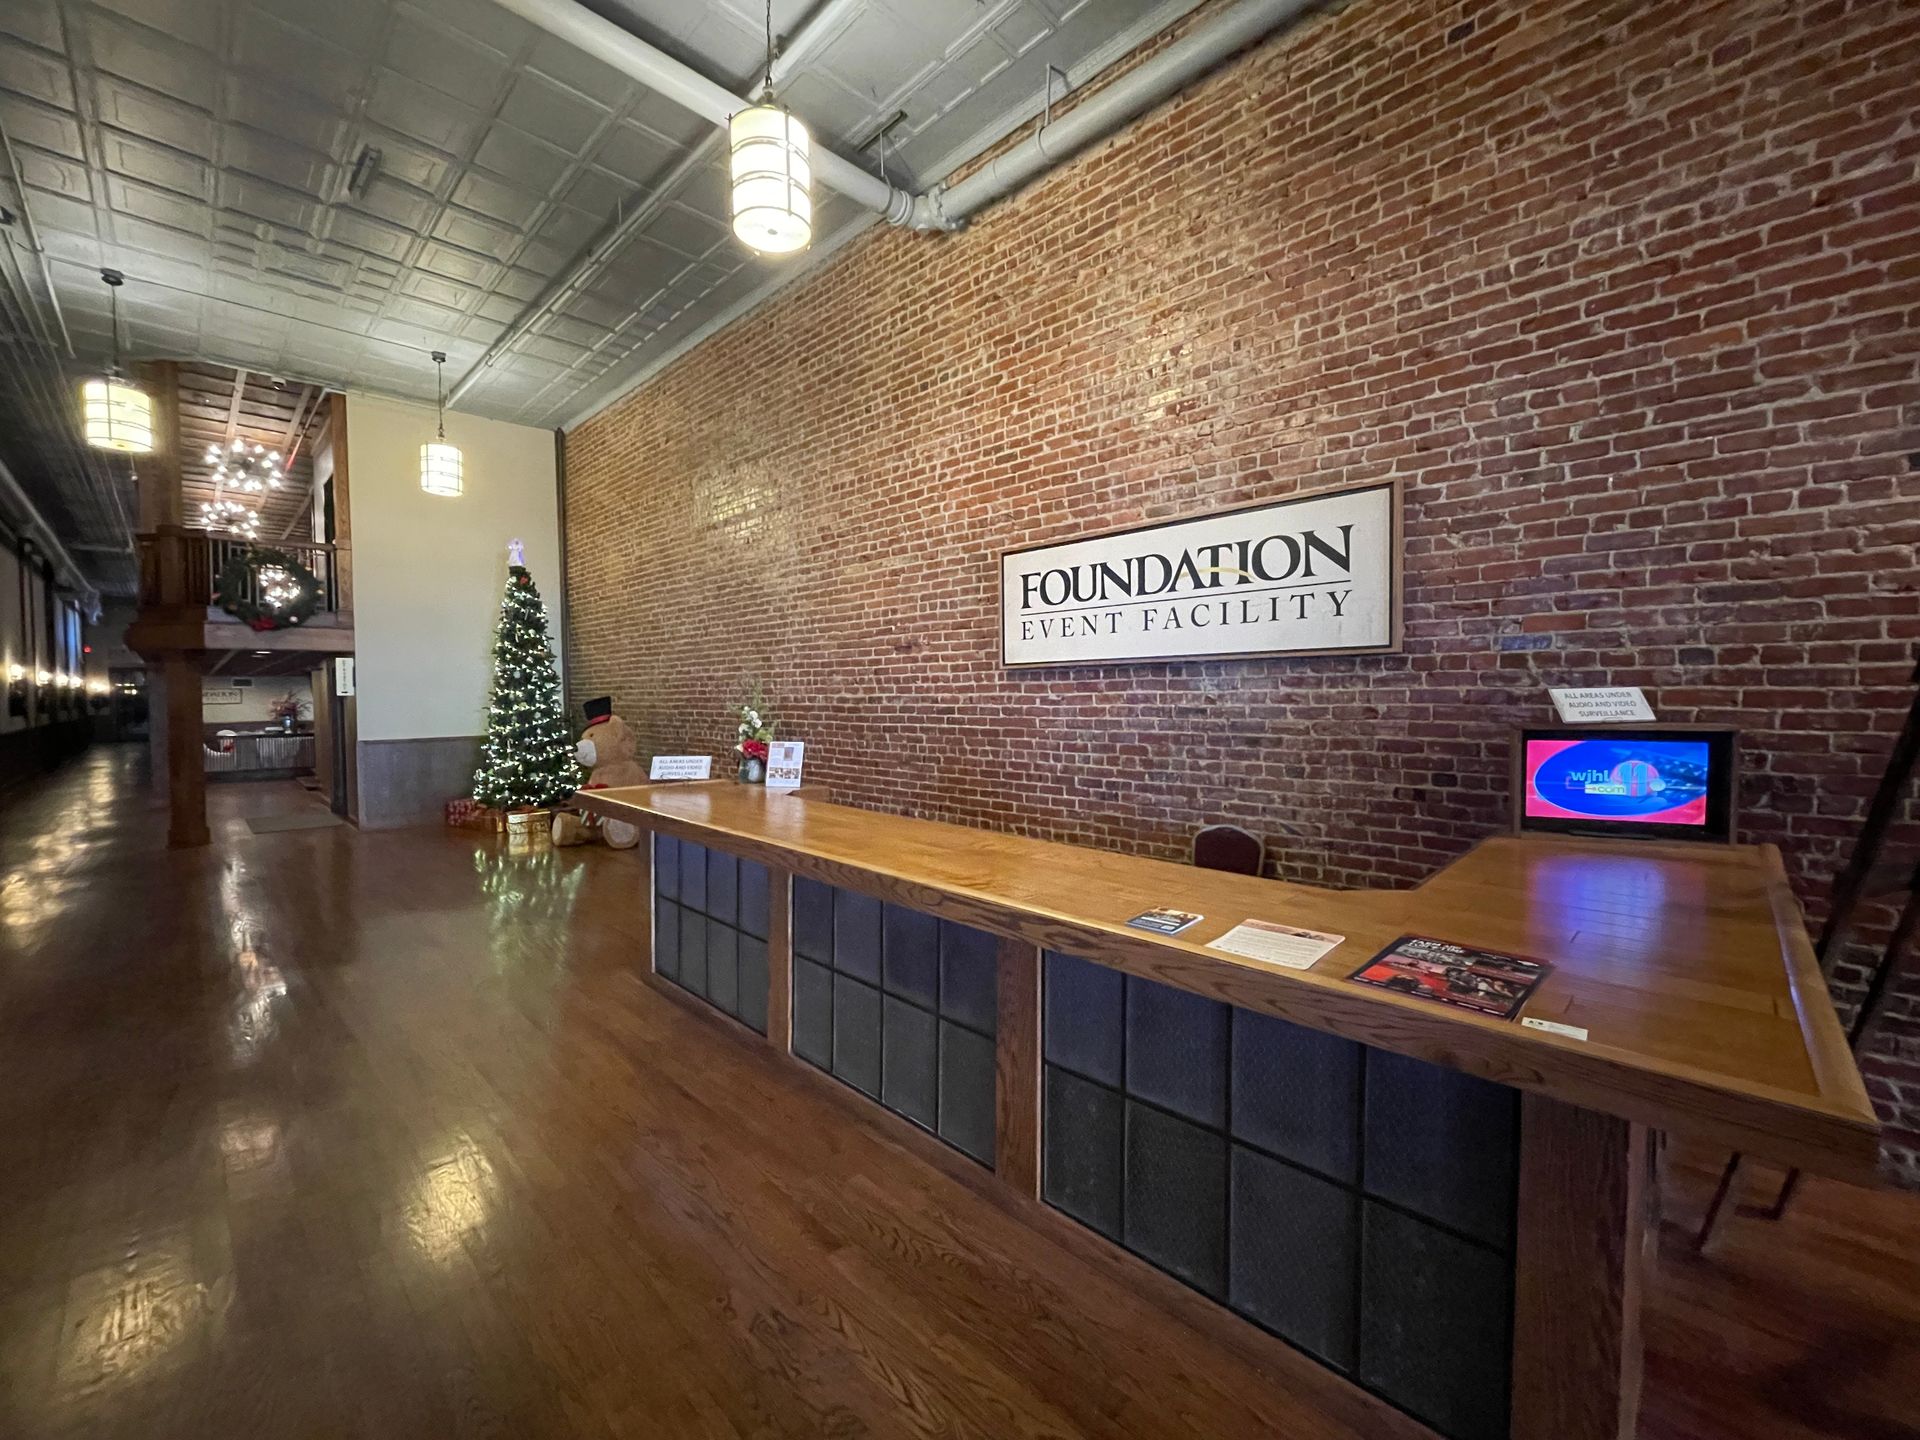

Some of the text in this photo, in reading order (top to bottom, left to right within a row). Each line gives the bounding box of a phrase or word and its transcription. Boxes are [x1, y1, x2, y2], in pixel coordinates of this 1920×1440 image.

[1020, 524, 1354, 609] FOUNDATION
[1020, 589, 1353, 641] EVENT FACILITY
[1579, 709, 1636, 717] SURVEILLANCE
[1570, 769, 1610, 784] wjhl
